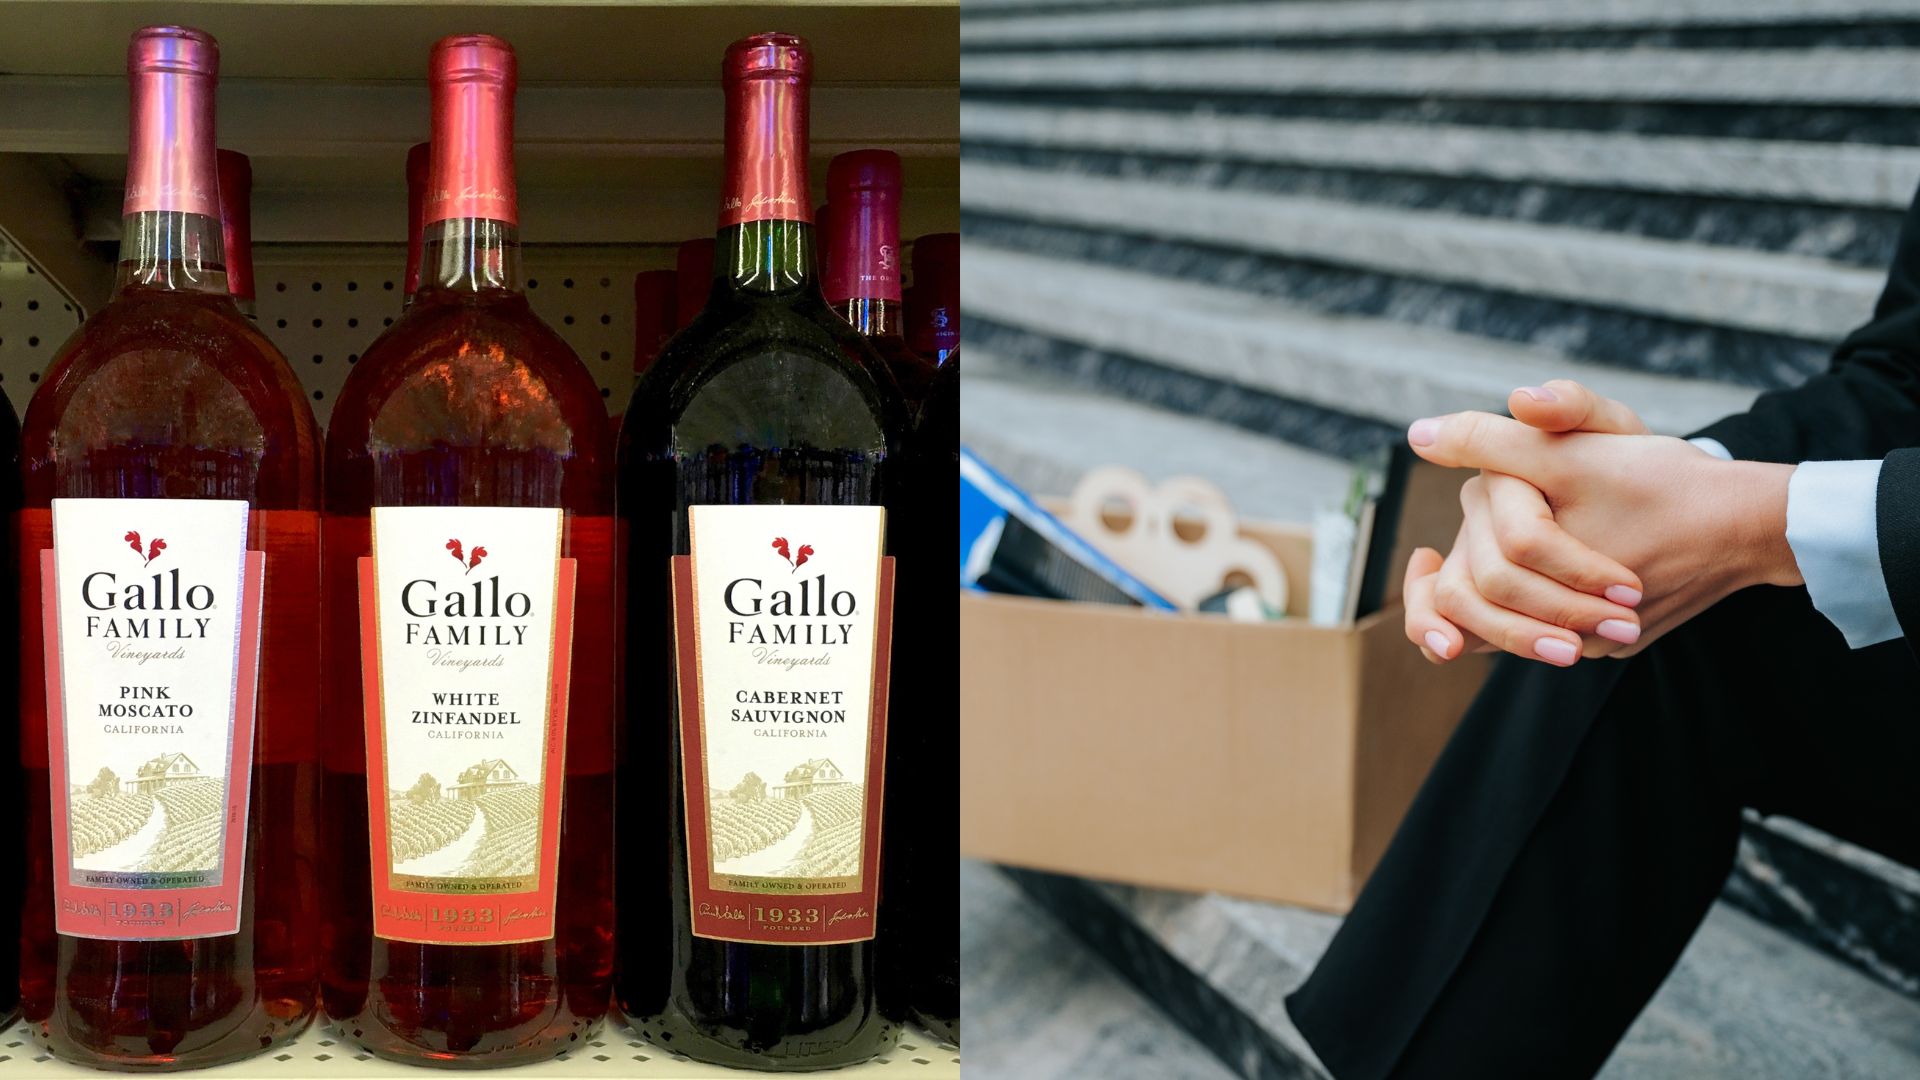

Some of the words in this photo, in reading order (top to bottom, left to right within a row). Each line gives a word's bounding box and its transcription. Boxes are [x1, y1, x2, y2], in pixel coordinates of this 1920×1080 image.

[82, 568, 215, 611] Gallo
[401, 575, 532, 618] Gallo
[723, 574, 856, 617] Gallo
[86, 616, 211, 639] FAMILY
[405, 623, 528, 646] FAMILY
[728, 622, 853, 645] FAMILY
[106, 641, 186, 666] Vineyards
[426, 648, 504, 673] Vineyards
[751, 646, 831, 672] Vineyards
[119, 686, 171, 699] PINK
[432, 692, 500, 706] WHITE
[735, 690, 844, 705] CABERNET
[98, 704, 194, 718] MOSCATO
[411, 710, 521, 725] ZINFANDEL
[731, 709, 846, 724] SAUVIGNON
[103, 724, 184, 735] CALIFORNIA
[427, 730, 505, 740] CALIFORNIA
[753, 729, 828, 739] CALIFORNIA
[86, 875, 114, 884] FAMILY
[116, 876, 148, 885] OWNED
[150, 877, 157, 885] &
[159, 875, 205, 885] OPERATED
[406, 880, 434, 889] FAMILY
[437, 882, 469, 890] OWNED
[479, 881, 522, 890] OPERATED
[728, 880, 759, 889] FAMILY
[762, 881, 794, 890] OWNED
[796, 882, 803, 890] &
[805, 881, 847, 890] OPERATED
[107, 901, 174, 919] 1933
[431, 907, 494, 923] 1933
[754, 907, 819, 923] 1933
